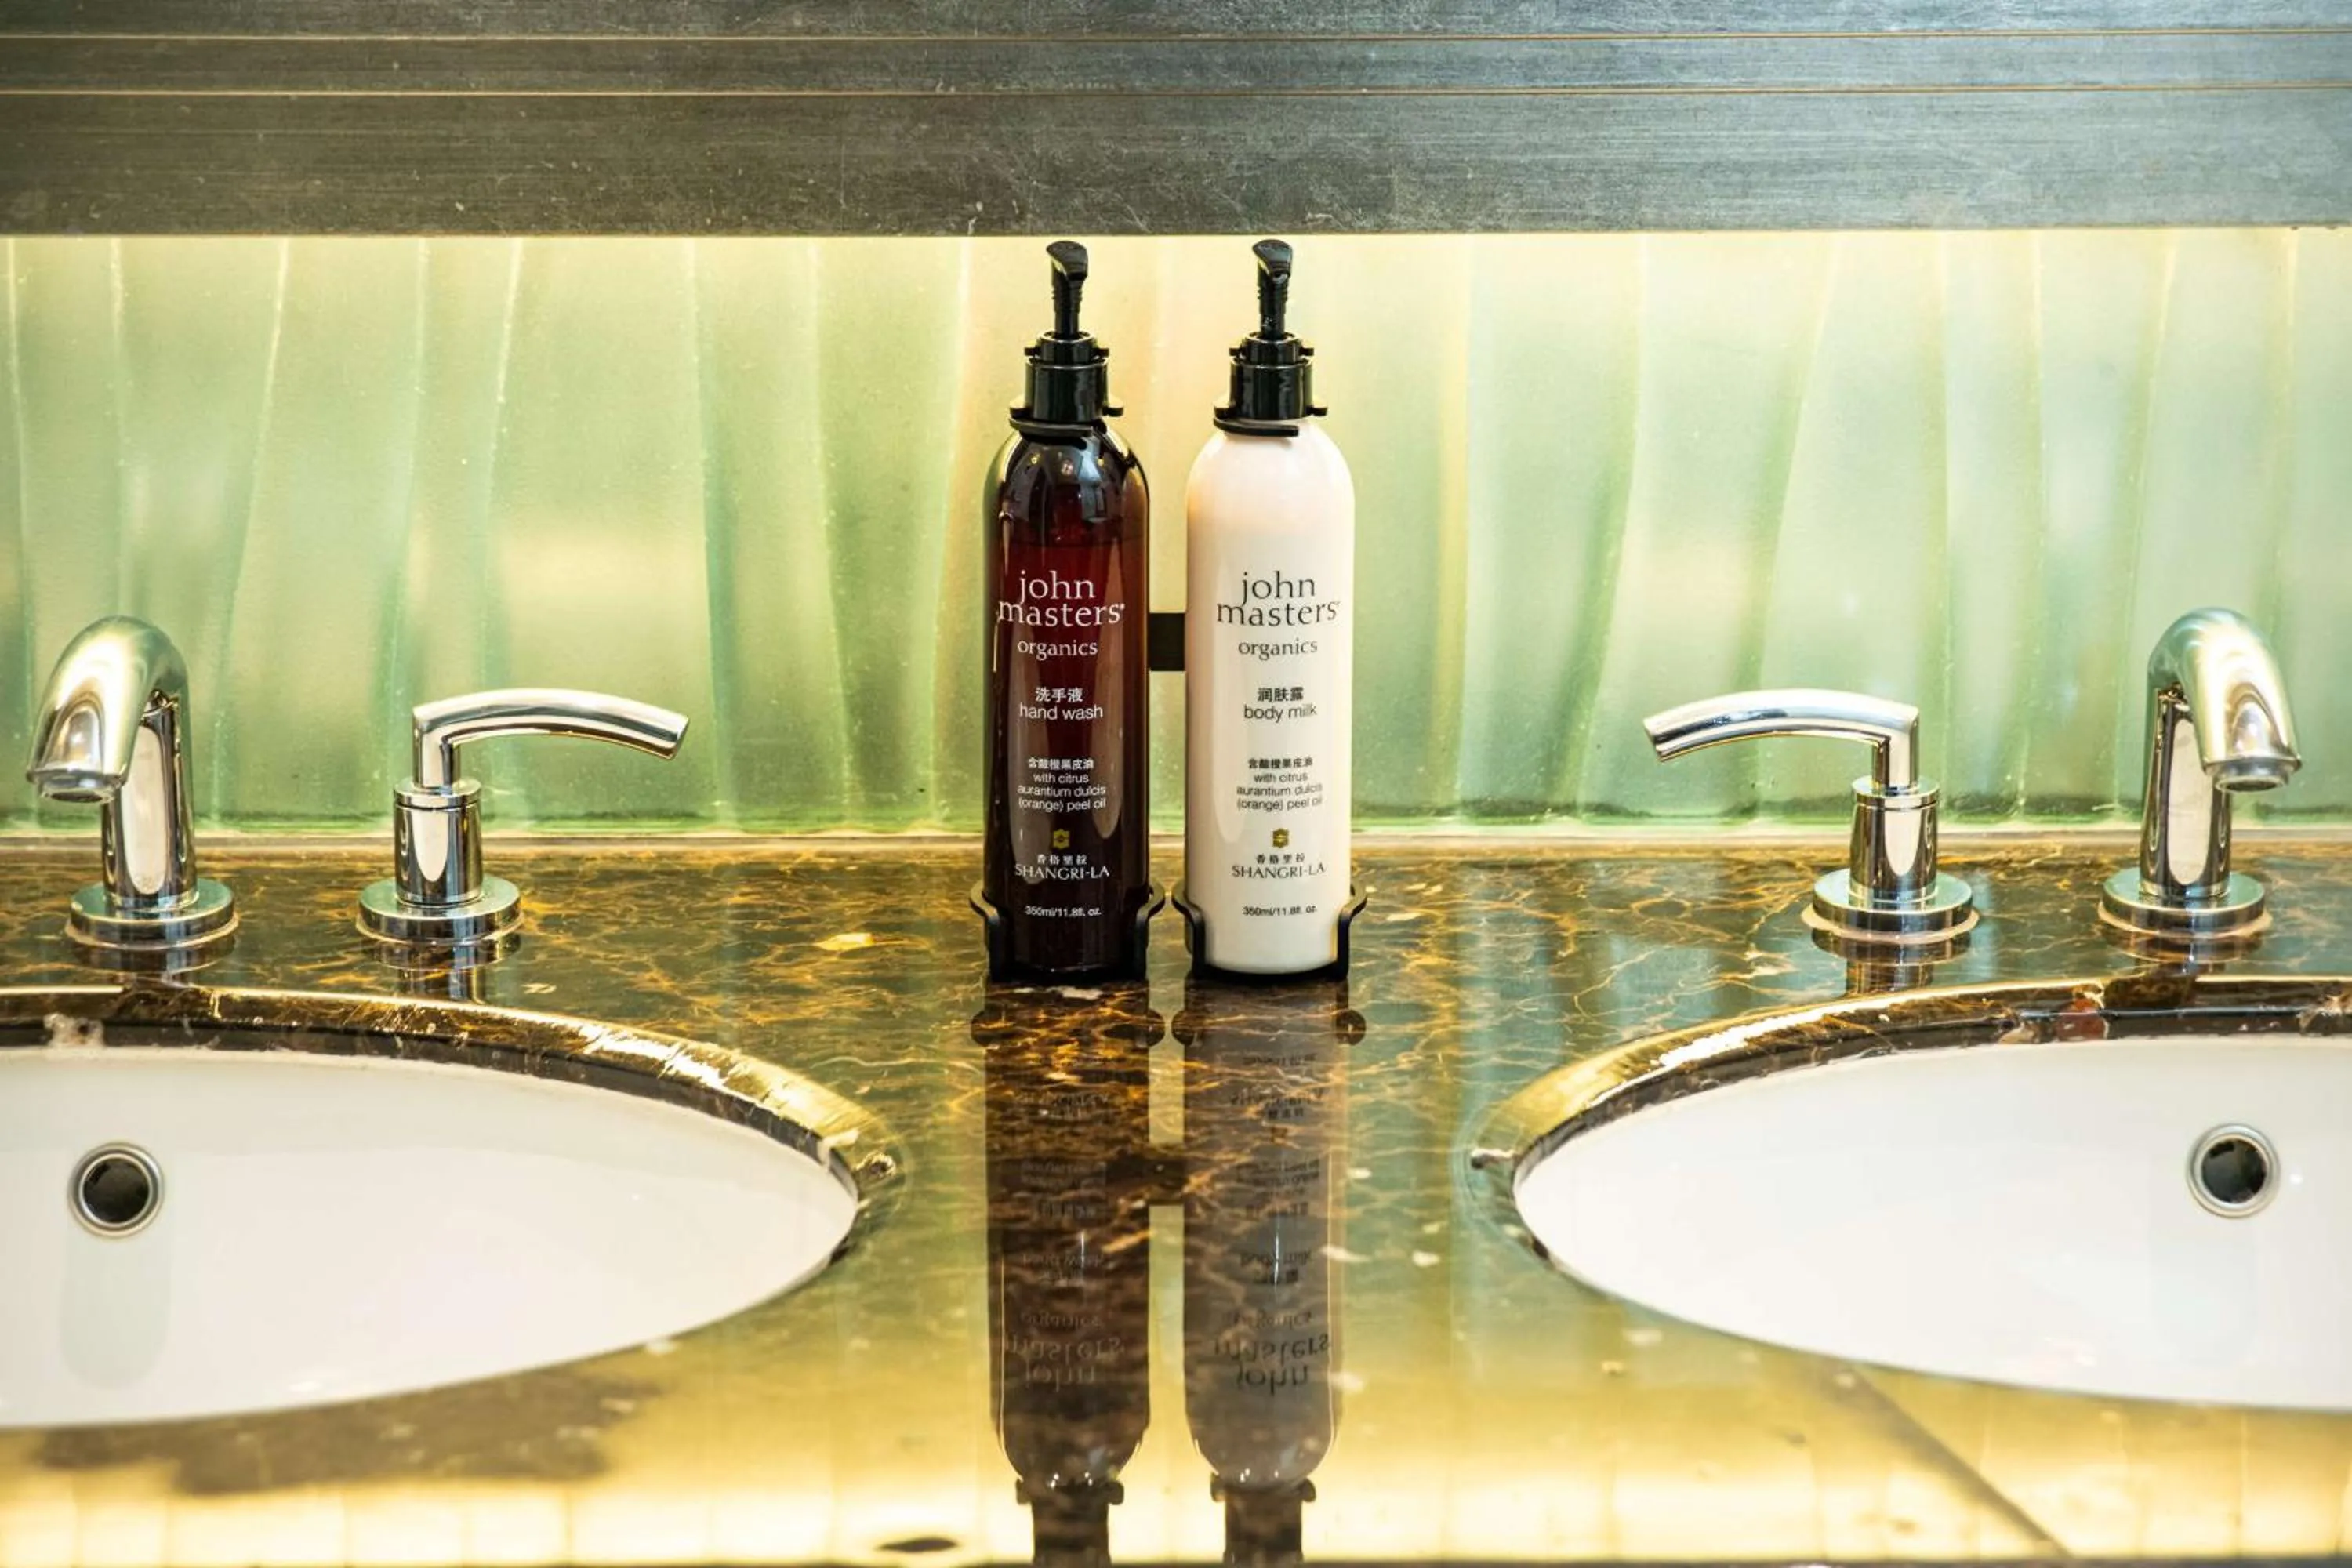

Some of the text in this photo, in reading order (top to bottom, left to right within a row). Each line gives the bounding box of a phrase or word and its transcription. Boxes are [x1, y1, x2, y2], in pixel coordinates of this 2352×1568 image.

[1020, 569, 1096, 604] john
[1242, 570, 1316, 607] john
[1018, 639, 1098, 661] organics
[1238, 637, 1318, 661] organics
[1035, 686, 1083, 703] 洗手液
[1257, 686, 1304, 702] 润肤露
[1019, 702, 1103, 720] hand wash
[1244, 703, 1317, 723] body milk
[1033, 772, 1090, 783] with citrus
[1254, 772, 1308, 783] with citrus
[1017, 784, 1107, 797] aurantium dulcis
[1236, 786, 1291, 797] aurantium
[1018, 797, 1106, 813] (orange) peel oil
[1237, 797, 1284, 812] (orange)
[1287, 797, 1310, 811] peel
[1014, 863, 1110, 880] SHANGRI-LA
[1231, 862, 1325, 879] SHANGRI-LA
